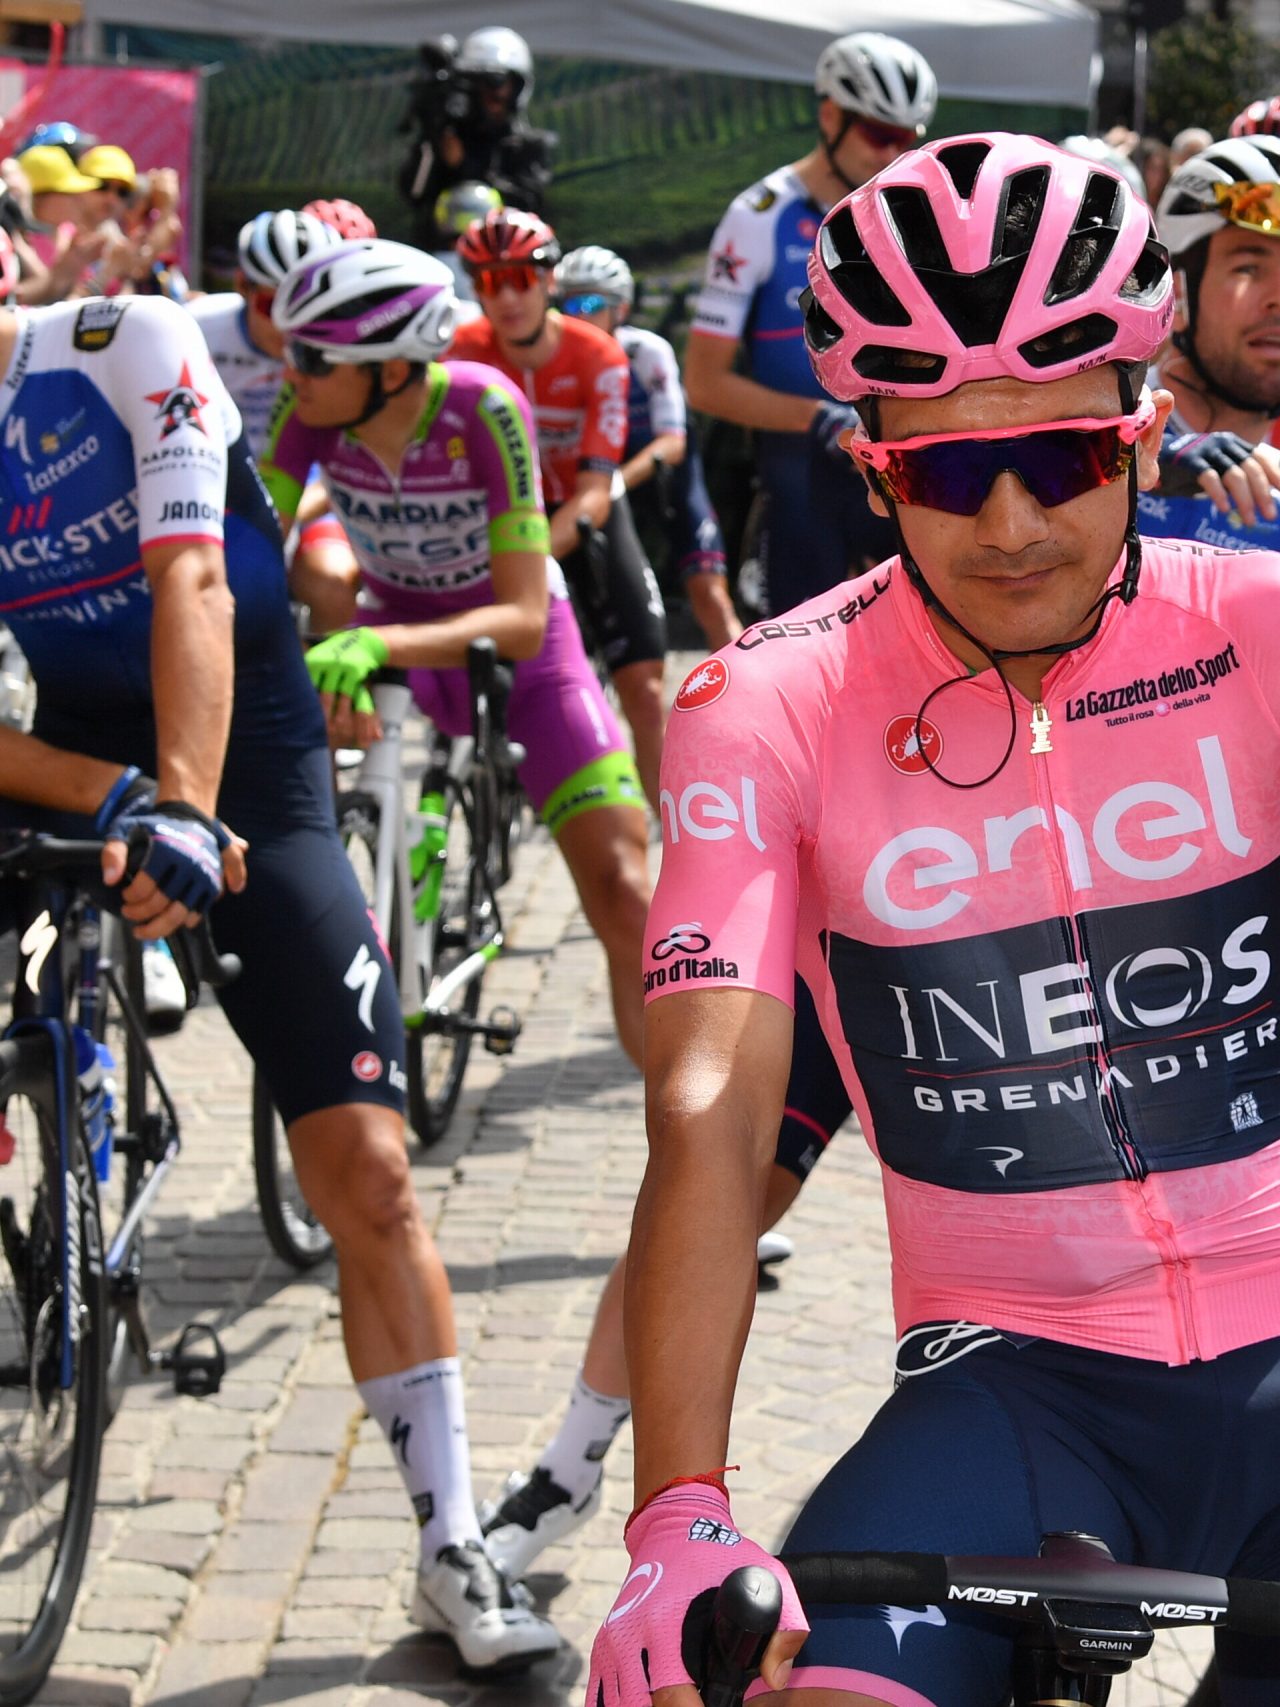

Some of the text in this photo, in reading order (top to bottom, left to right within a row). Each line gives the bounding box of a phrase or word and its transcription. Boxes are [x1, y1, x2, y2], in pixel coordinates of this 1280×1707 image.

[24, 435, 100, 495] latexco
[1087, 678, 1158, 716] Gazzetta
[1158, 666, 1198, 698] dello
[1195, 641, 1240, 687] Sport
[1105, 716, 1129, 727] Tutto
[1135, 709, 1154, 720] rosa
[1173, 697, 1194, 711] della
[1194, 692, 1211, 704] vita
[863, 735, 1253, 931] enel
[669, 957, 739, 983] d'Italia
[888, 915, 1272, 1062] INEOS
[913, 1017, 1278, 1113] GRENADIER
[1079, 1638, 1133, 1651] GARMIN
